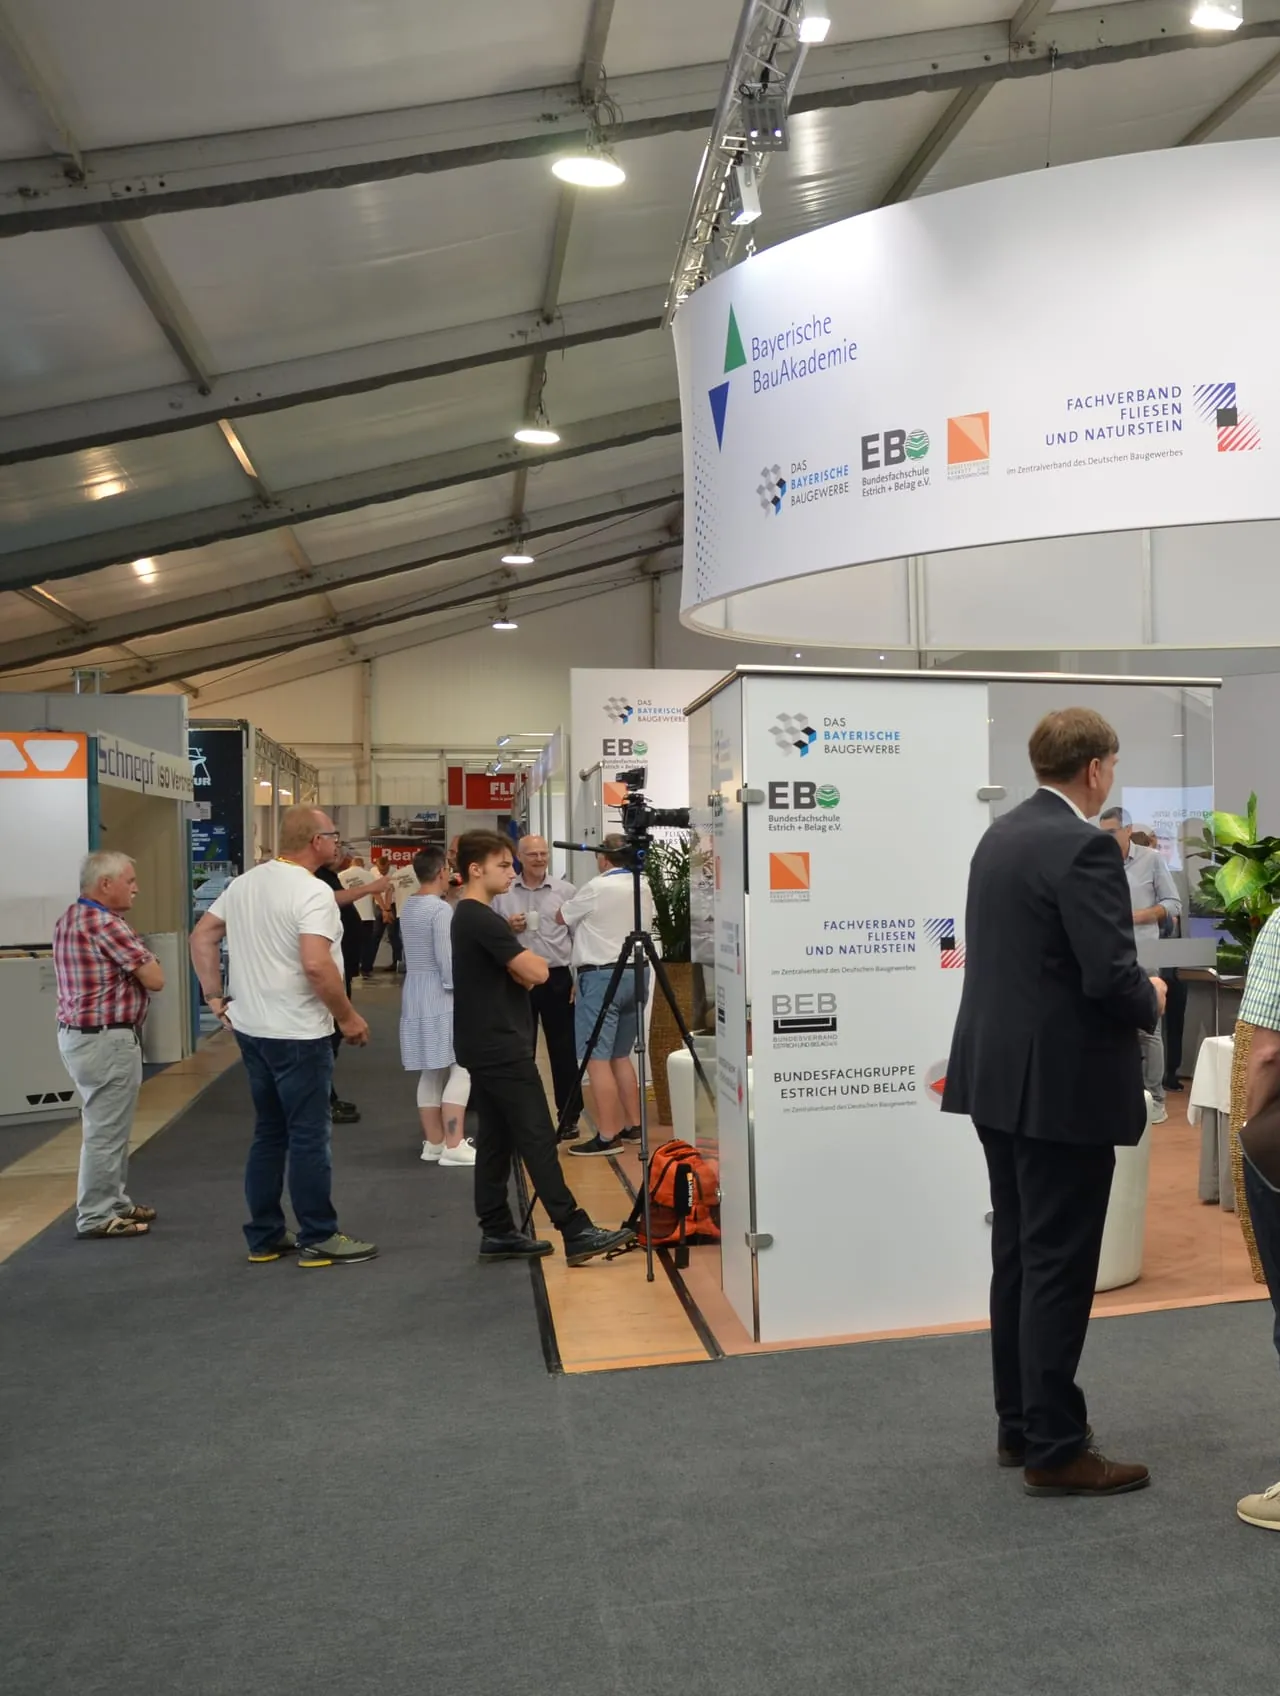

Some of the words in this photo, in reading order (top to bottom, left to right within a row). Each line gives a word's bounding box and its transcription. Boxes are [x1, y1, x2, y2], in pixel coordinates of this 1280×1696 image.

[751, 314, 832, 361] Bayerische
[753, 338, 857, 394] BauAkademie
[1067, 386, 1183, 411] FACHVERBAND
[1120, 403, 1183, 420] FLIESEN
[1045, 431, 1078, 446] UND
[1084, 419, 1183, 441] NATURSTEIN
[791, 460, 808, 474] DAS
[1017, 459, 1072, 474] Zentralverband
[1073, 457, 1086, 467] des
[1088, 453, 1128, 466] Deutschen
[1130, 449, 1183, 462] Baugewerbes
[791, 465, 849, 490] BAYERISCHE
[862, 466, 930, 487] Bundesfachschule
[790, 482, 849, 507] BAUGEWERBE
[862, 484, 886, 497] Estrich
[894, 479, 916, 492] Belag
[823, 717, 846, 727] DAS
[824, 731, 901, 741] BAYERISCHE
[824, 744, 901, 754] BAUGEWERBE
[98, 735, 154, 793] Schnepf
[768, 823, 795, 831] Estrich
[804, 823, 827, 832] Belag
[824, 919, 916, 930] FACHVERBAND
[868, 931, 916, 941] FLIESEN
[805, 946, 834, 955] UND
[839, 943, 916, 955] NATURSTEIN
[772, 992, 838, 1015] BEB
[774, 1065, 916, 1083] BUNDESFACHGRUPPE
[780, 1085, 837, 1099] ESTRICH
[841, 1083, 870, 1095] UND
[874, 1081, 916, 1094] BELAG
